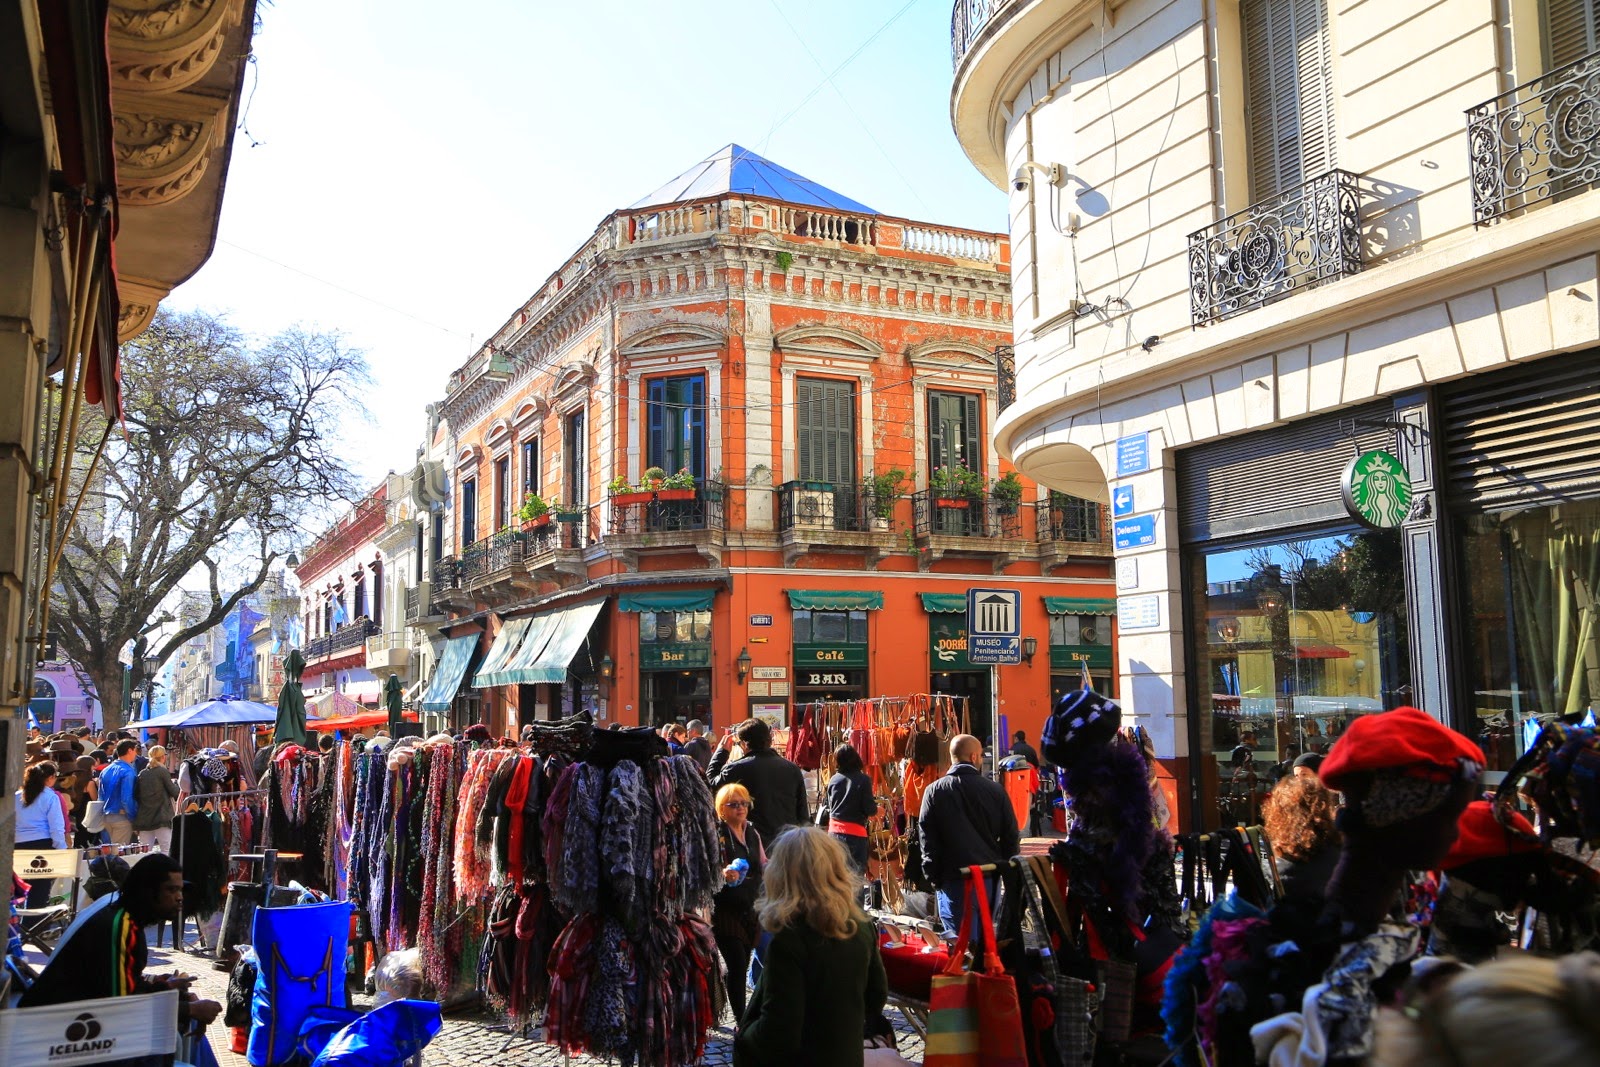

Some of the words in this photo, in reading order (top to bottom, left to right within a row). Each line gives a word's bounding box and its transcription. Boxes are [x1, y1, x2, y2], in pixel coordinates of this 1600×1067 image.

[1117, 525, 1141, 535] Defensa
[661, 651, 685, 661] Bar
[816, 650, 845, 660] Café
[1071, 653, 1091, 661] Bar
[808, 673, 847, 685] BAR
[48, 1040, 113, 1057] ICELAND
